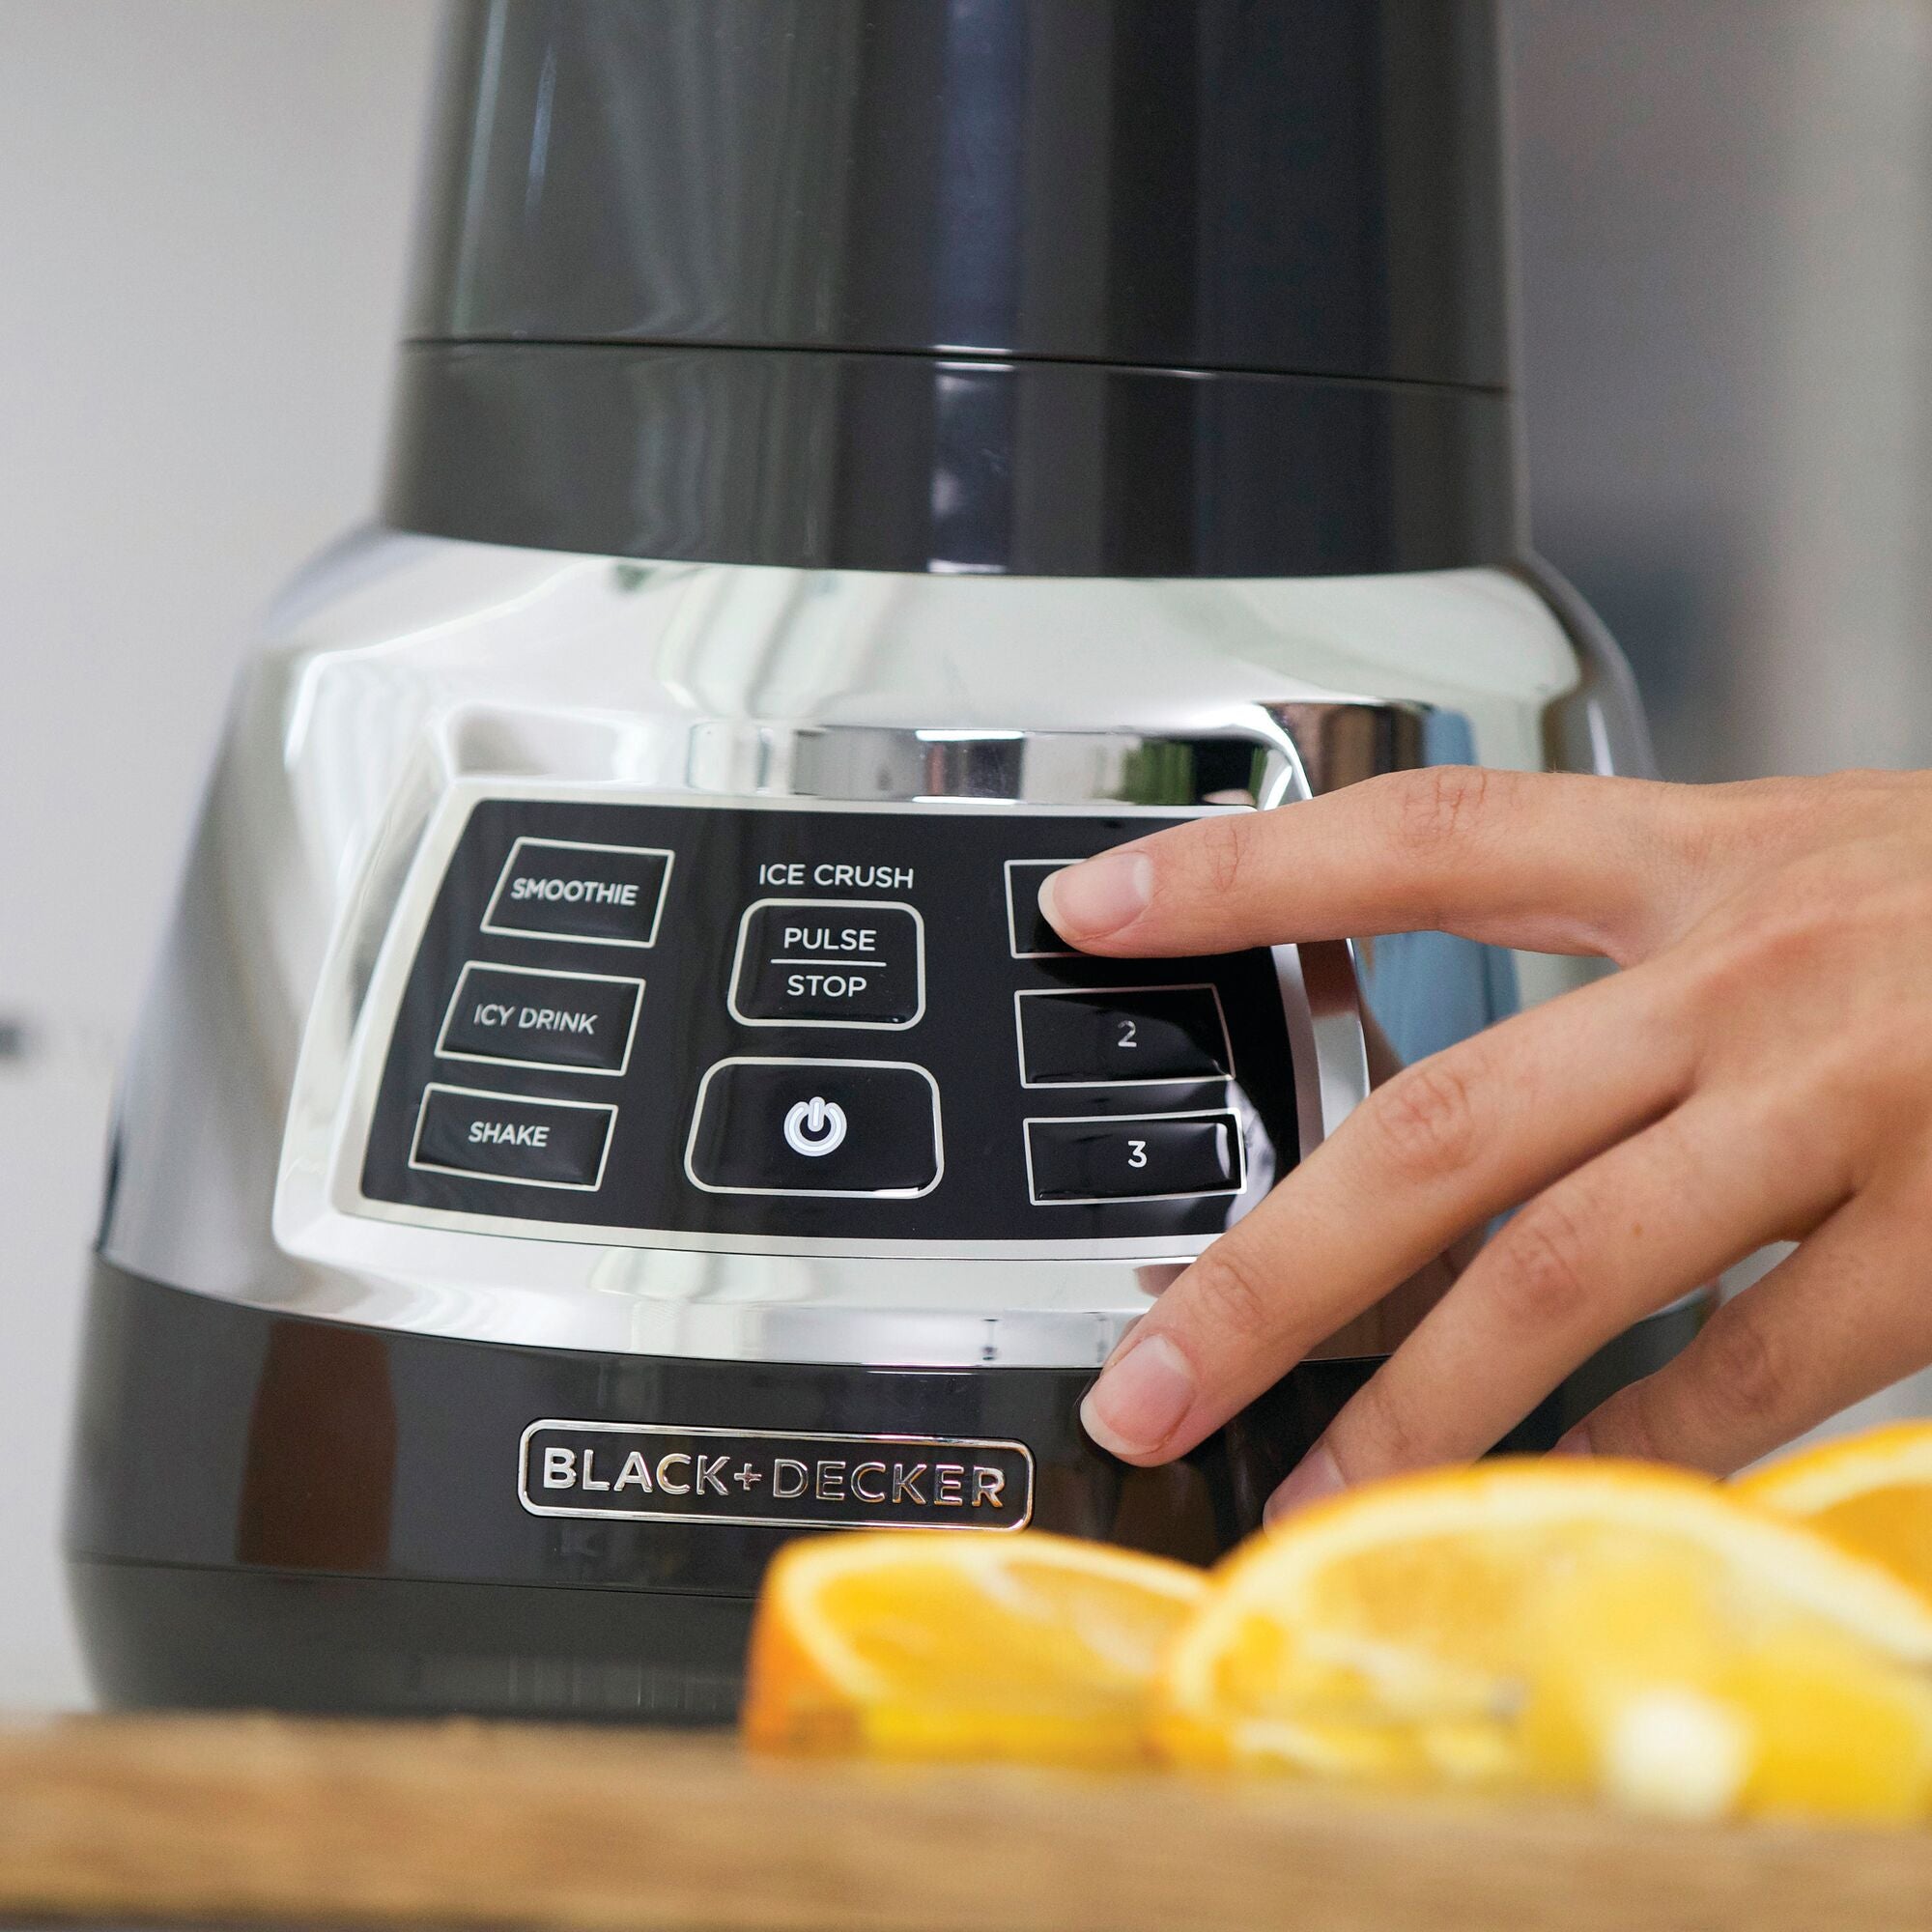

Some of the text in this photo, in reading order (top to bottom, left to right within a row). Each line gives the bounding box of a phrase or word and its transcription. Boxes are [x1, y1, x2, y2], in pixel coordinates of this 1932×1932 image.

[759, 864, 914, 889] ICE CRUSH
[511, 877, 639, 906] SMOOTHIE
[783, 927, 876, 952] PULSE
[786, 975, 867, 998] STOP
[473, 1003, 597, 1035] ICY DRINK
[1117, 1020, 1137, 1047] 2
[469, 1121, 549, 1149] SHAKE
[1127, 1140, 1148, 1168] 3
[542, 1446, 1008, 1508] BLACK+DECKER
